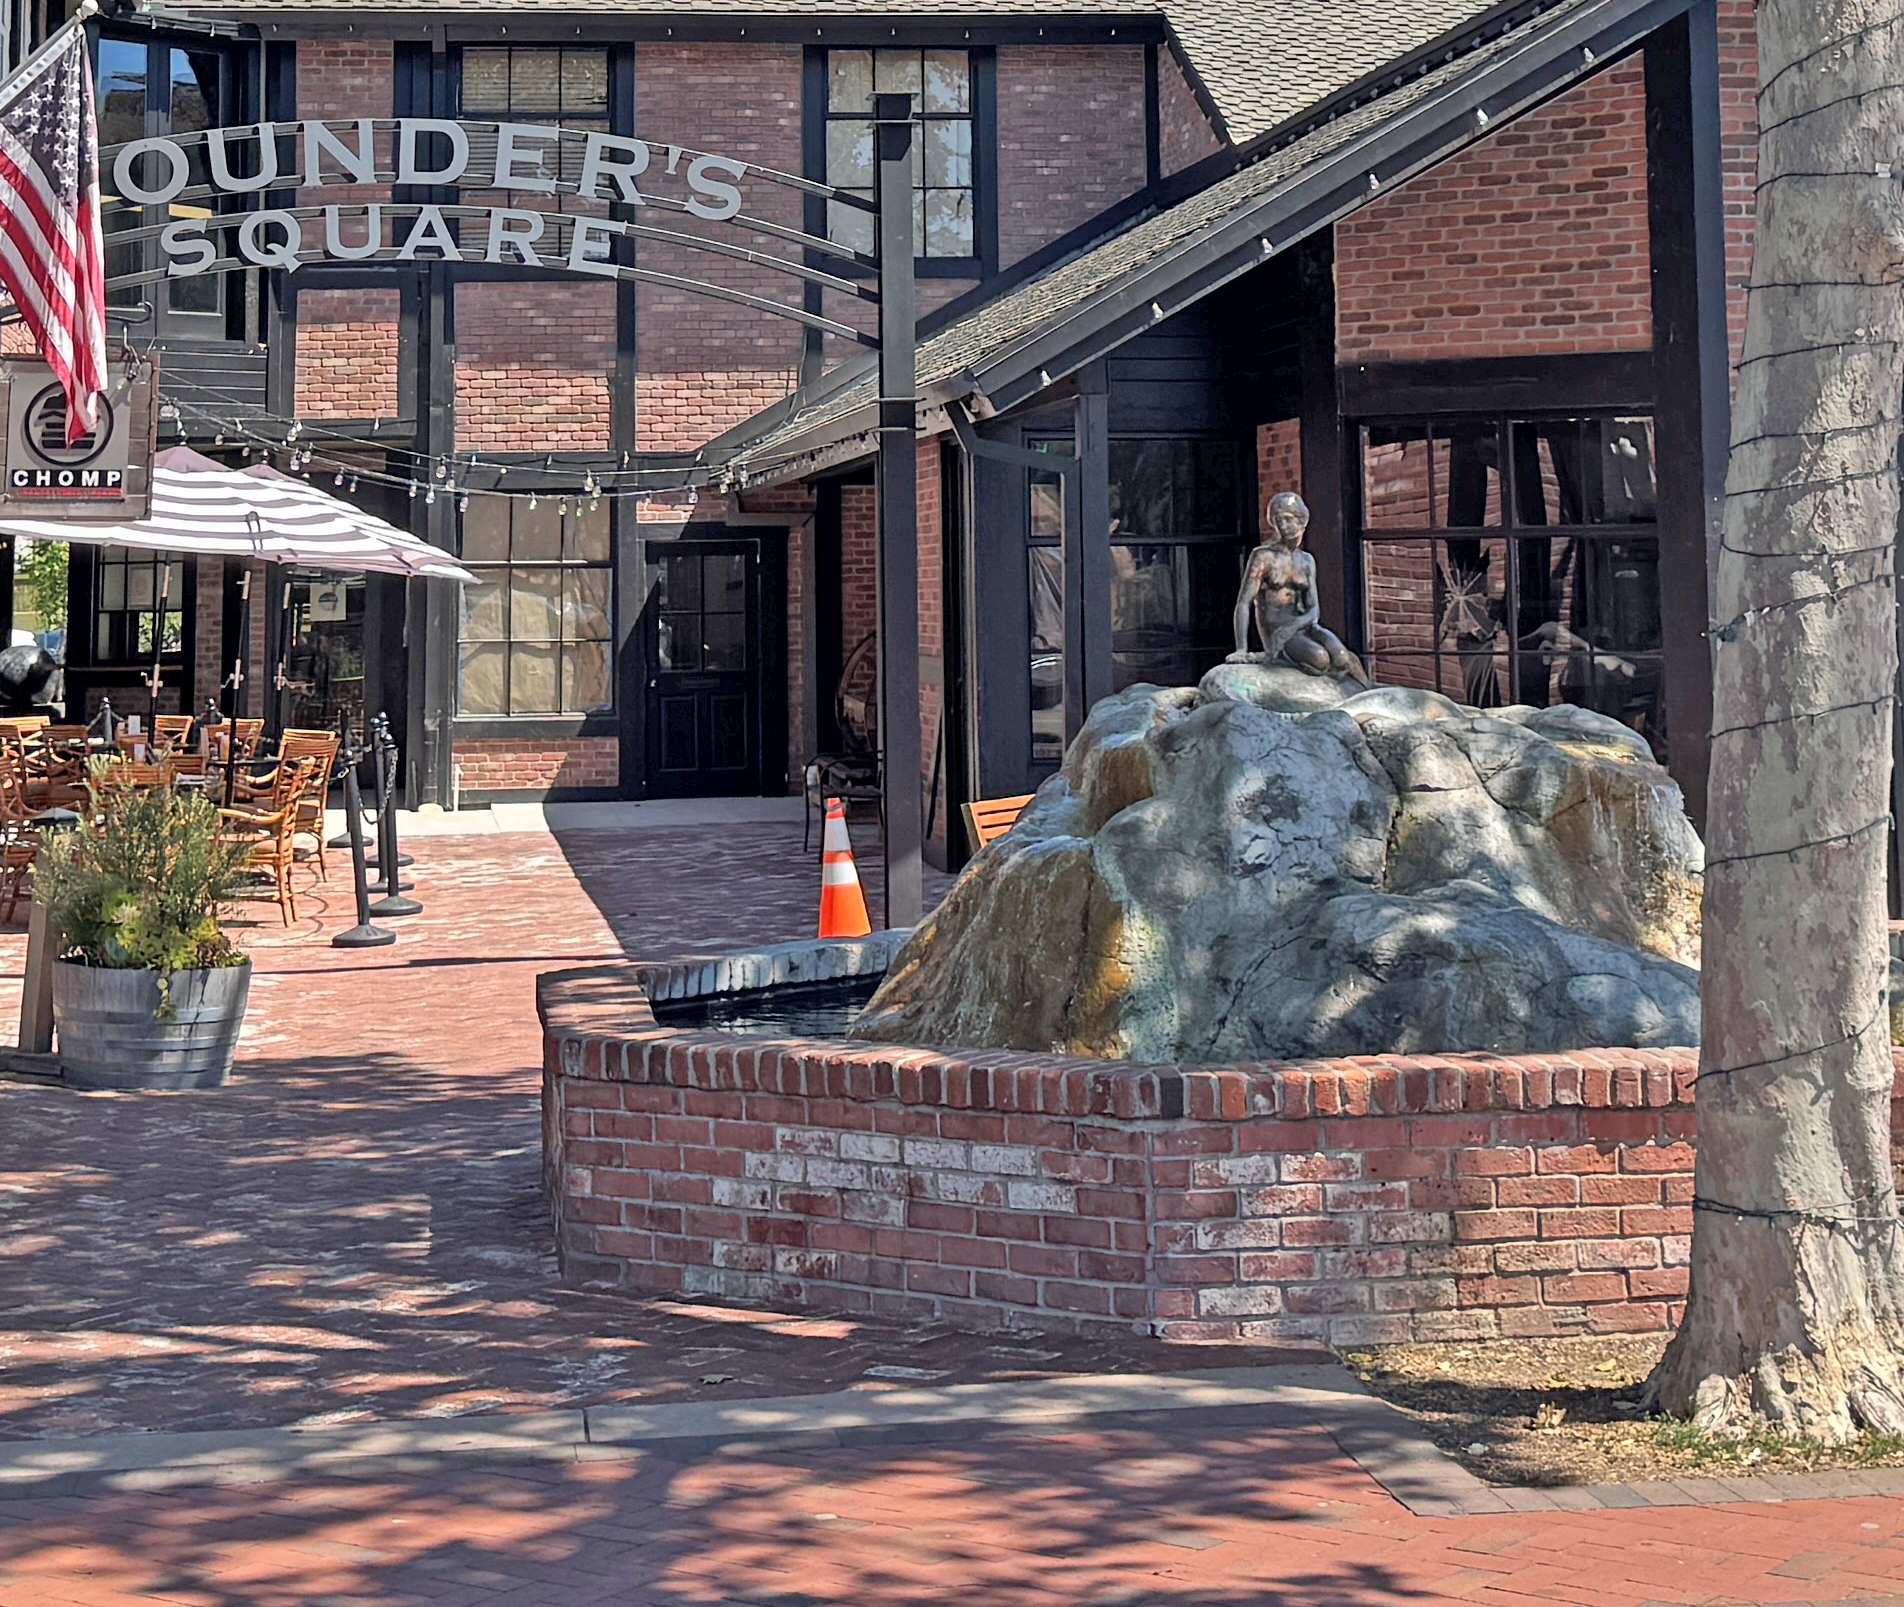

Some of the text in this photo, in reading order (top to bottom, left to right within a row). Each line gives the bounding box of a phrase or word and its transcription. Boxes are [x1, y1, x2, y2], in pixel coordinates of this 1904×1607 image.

[112, 118, 748, 221] OUNDER'S
[160, 204, 628, 279] SQUARE
[13, 470, 122, 487] CHOMP
